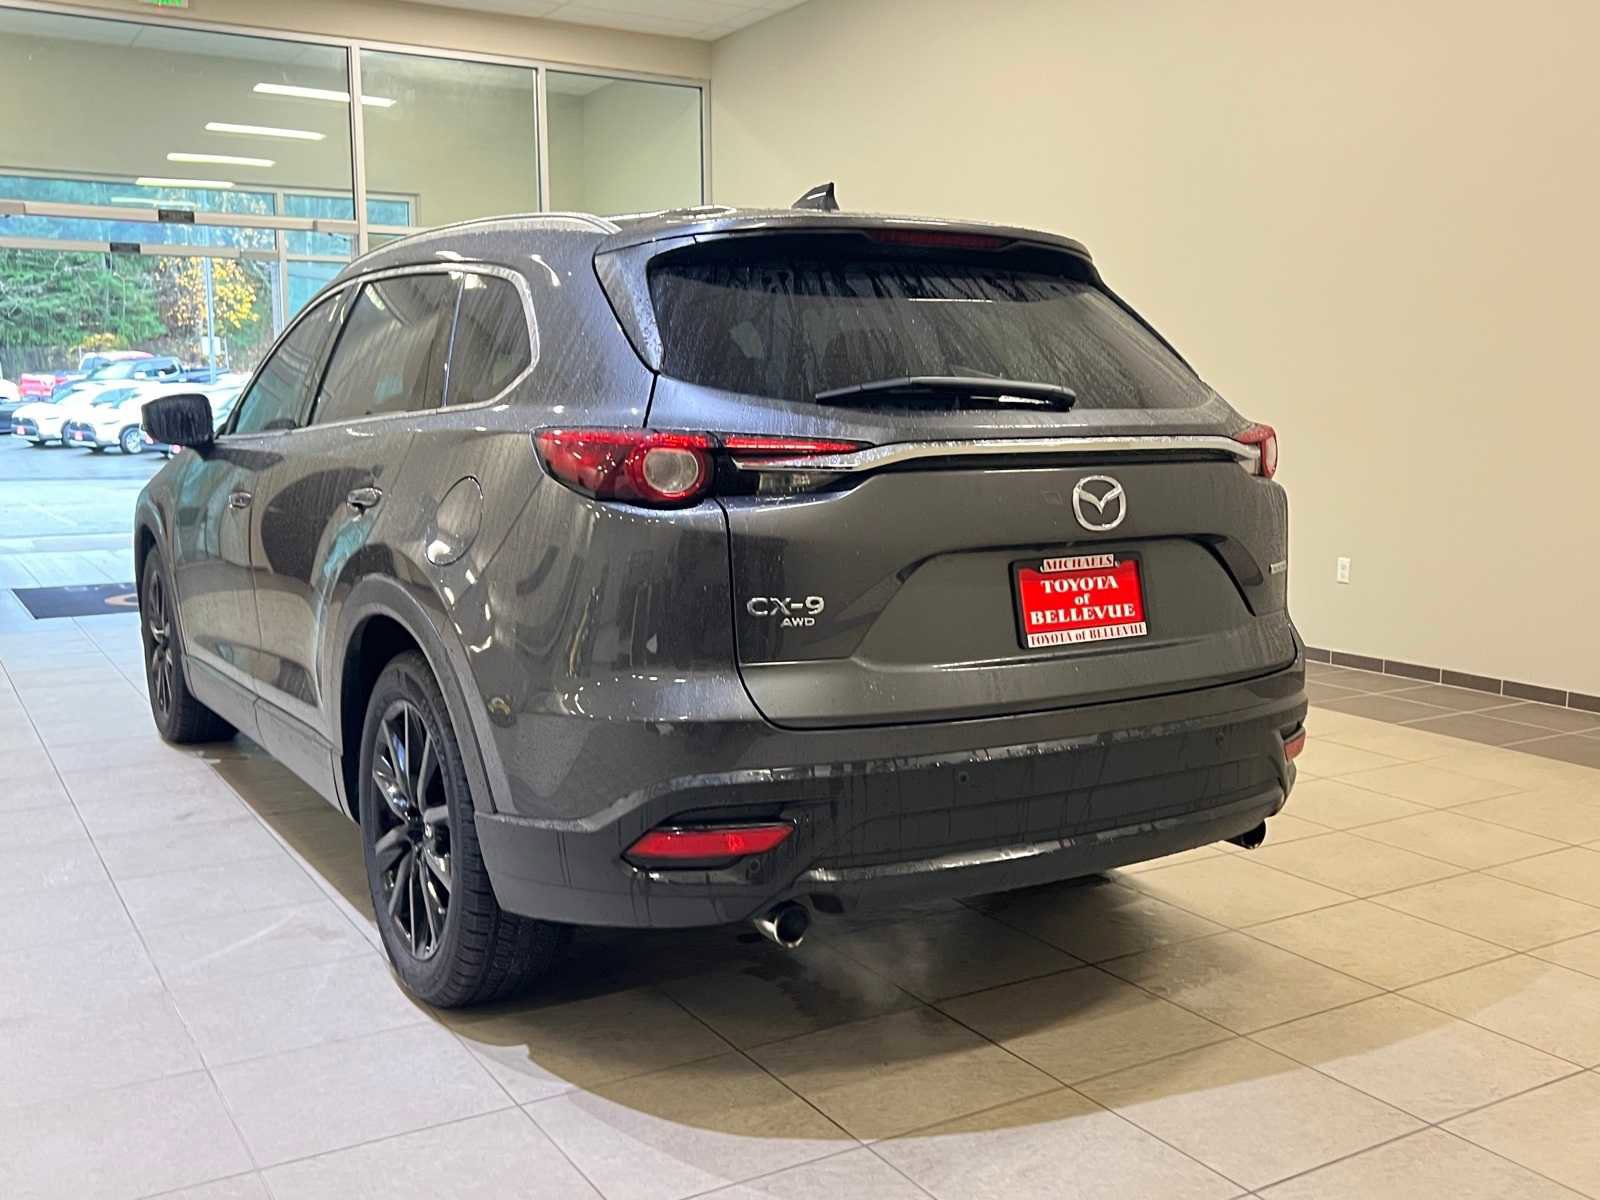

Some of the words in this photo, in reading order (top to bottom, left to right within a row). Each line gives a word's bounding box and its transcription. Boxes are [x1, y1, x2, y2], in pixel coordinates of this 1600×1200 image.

[1040, 576, 1119, 594] TOYOTA
[746, 596, 825, 615] CX-9
[1074, 593, 1090, 605] of
[780, 617, 815, 628] AWD
[1030, 604, 1136, 625] BELLEVUE
[1030, 632, 1073, 646] TOYOTA
[1075, 631, 1087, 641] of
